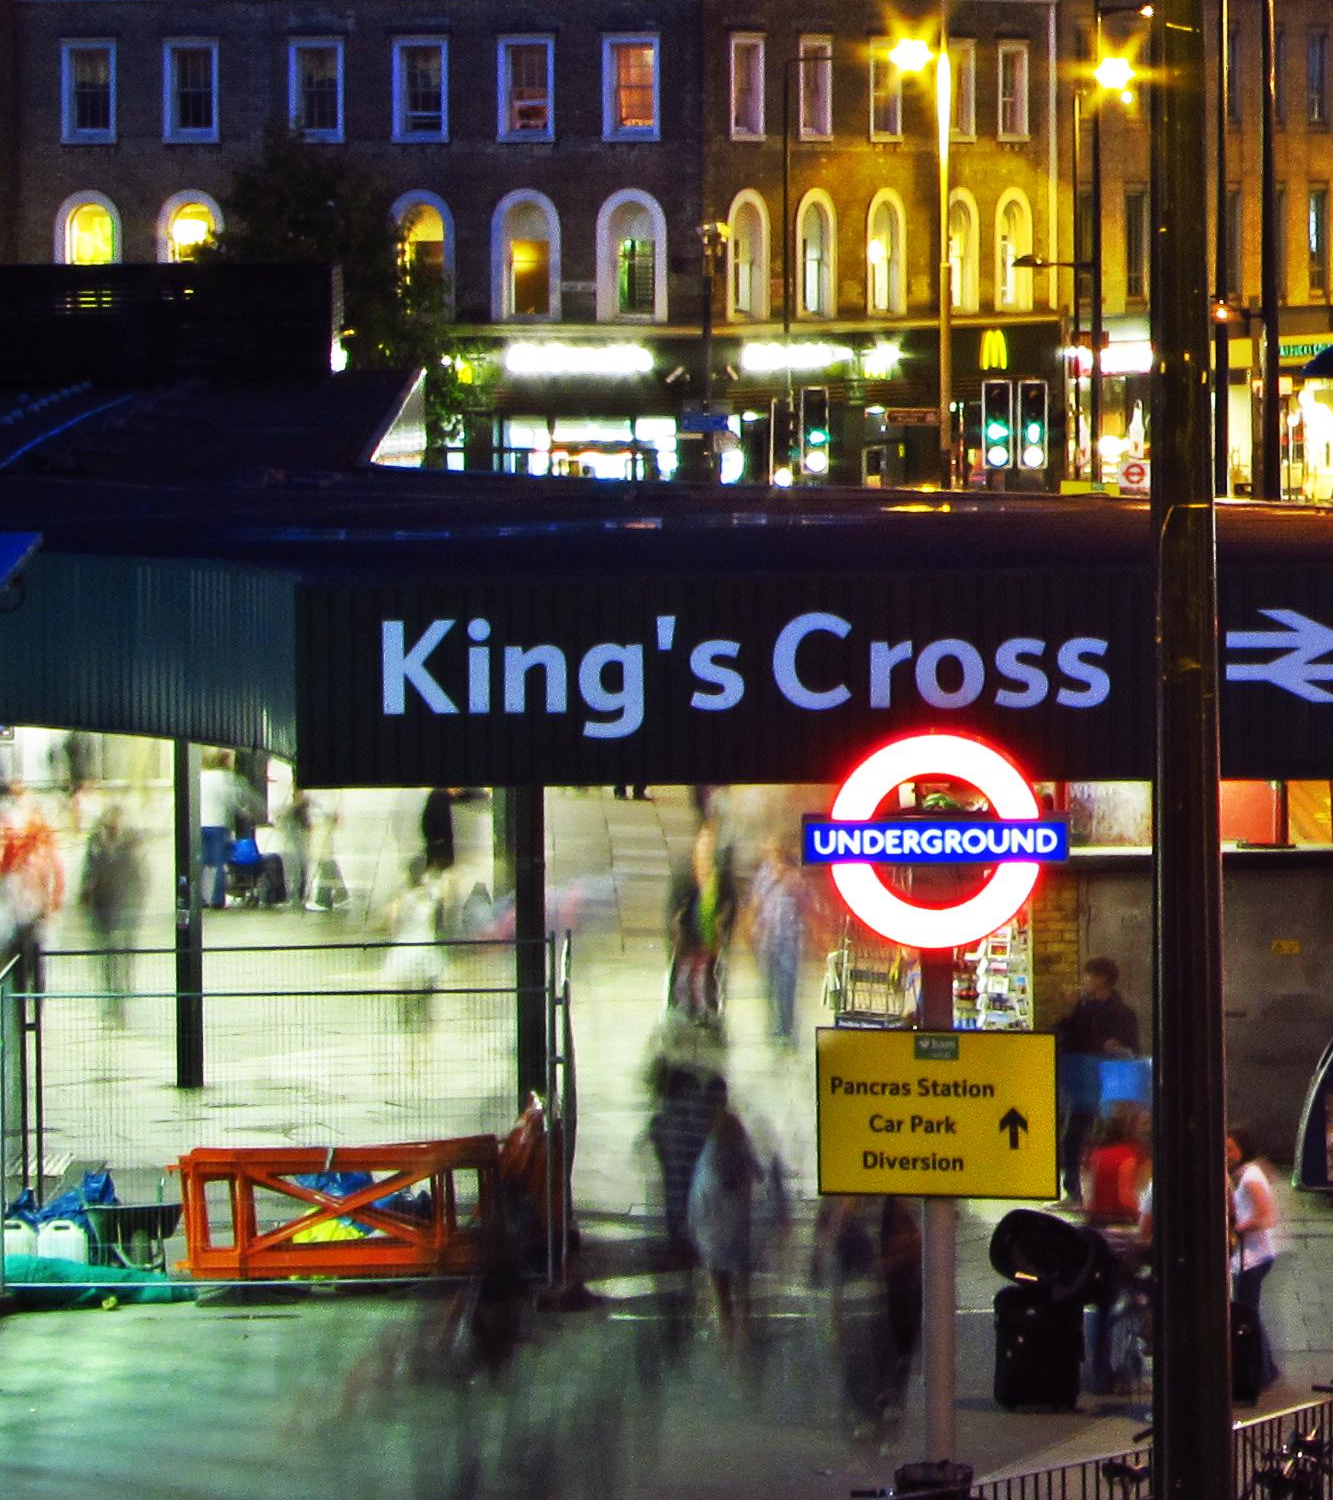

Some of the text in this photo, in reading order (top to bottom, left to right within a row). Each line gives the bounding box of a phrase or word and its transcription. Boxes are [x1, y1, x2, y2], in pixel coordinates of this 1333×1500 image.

[381, 611, 1111, 739] King's Cross
[813, 827, 1058, 856] UNDERGROUND
[831, 1076, 995, 1098] Pancras Station
[869, 1113, 957, 1135] Car Park
[862, 1150, 965, 1172] Diversion
